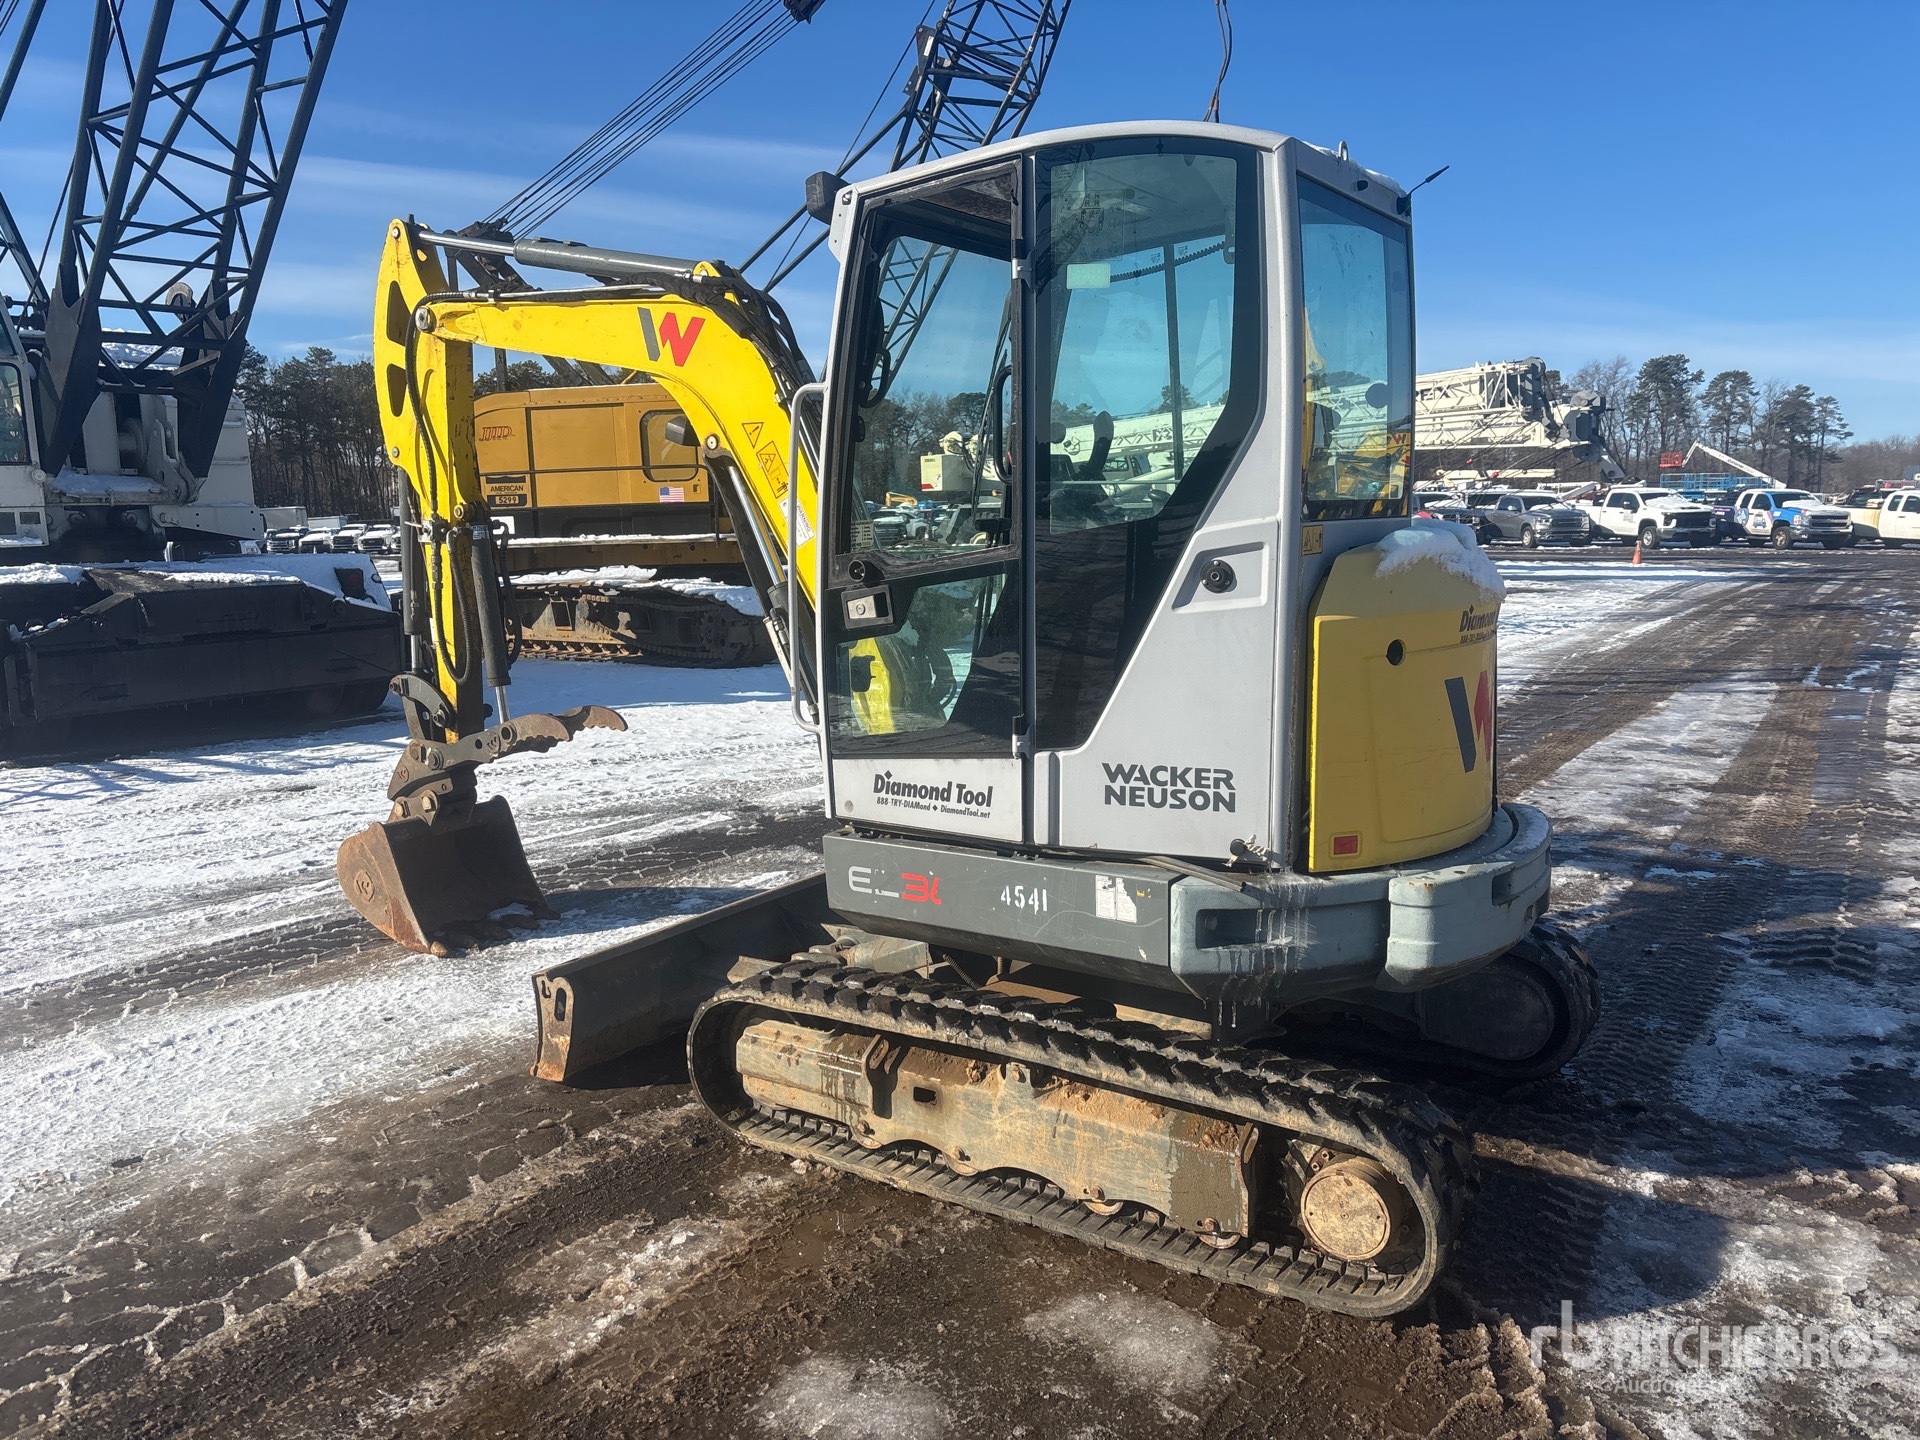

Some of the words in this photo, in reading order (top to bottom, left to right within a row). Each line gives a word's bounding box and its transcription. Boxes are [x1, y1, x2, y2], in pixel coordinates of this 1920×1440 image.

[498, 496, 517, 504] 5299
[873, 770, 953, 802] Diamond
[955, 783, 993, 807] Tool
[1101, 762, 1236, 791] WACKER
[940, 804, 991, 819] DiamondTool.net
[1104, 784, 1236, 813] NEUSON
[1000, 885, 1048, 914] 4541
